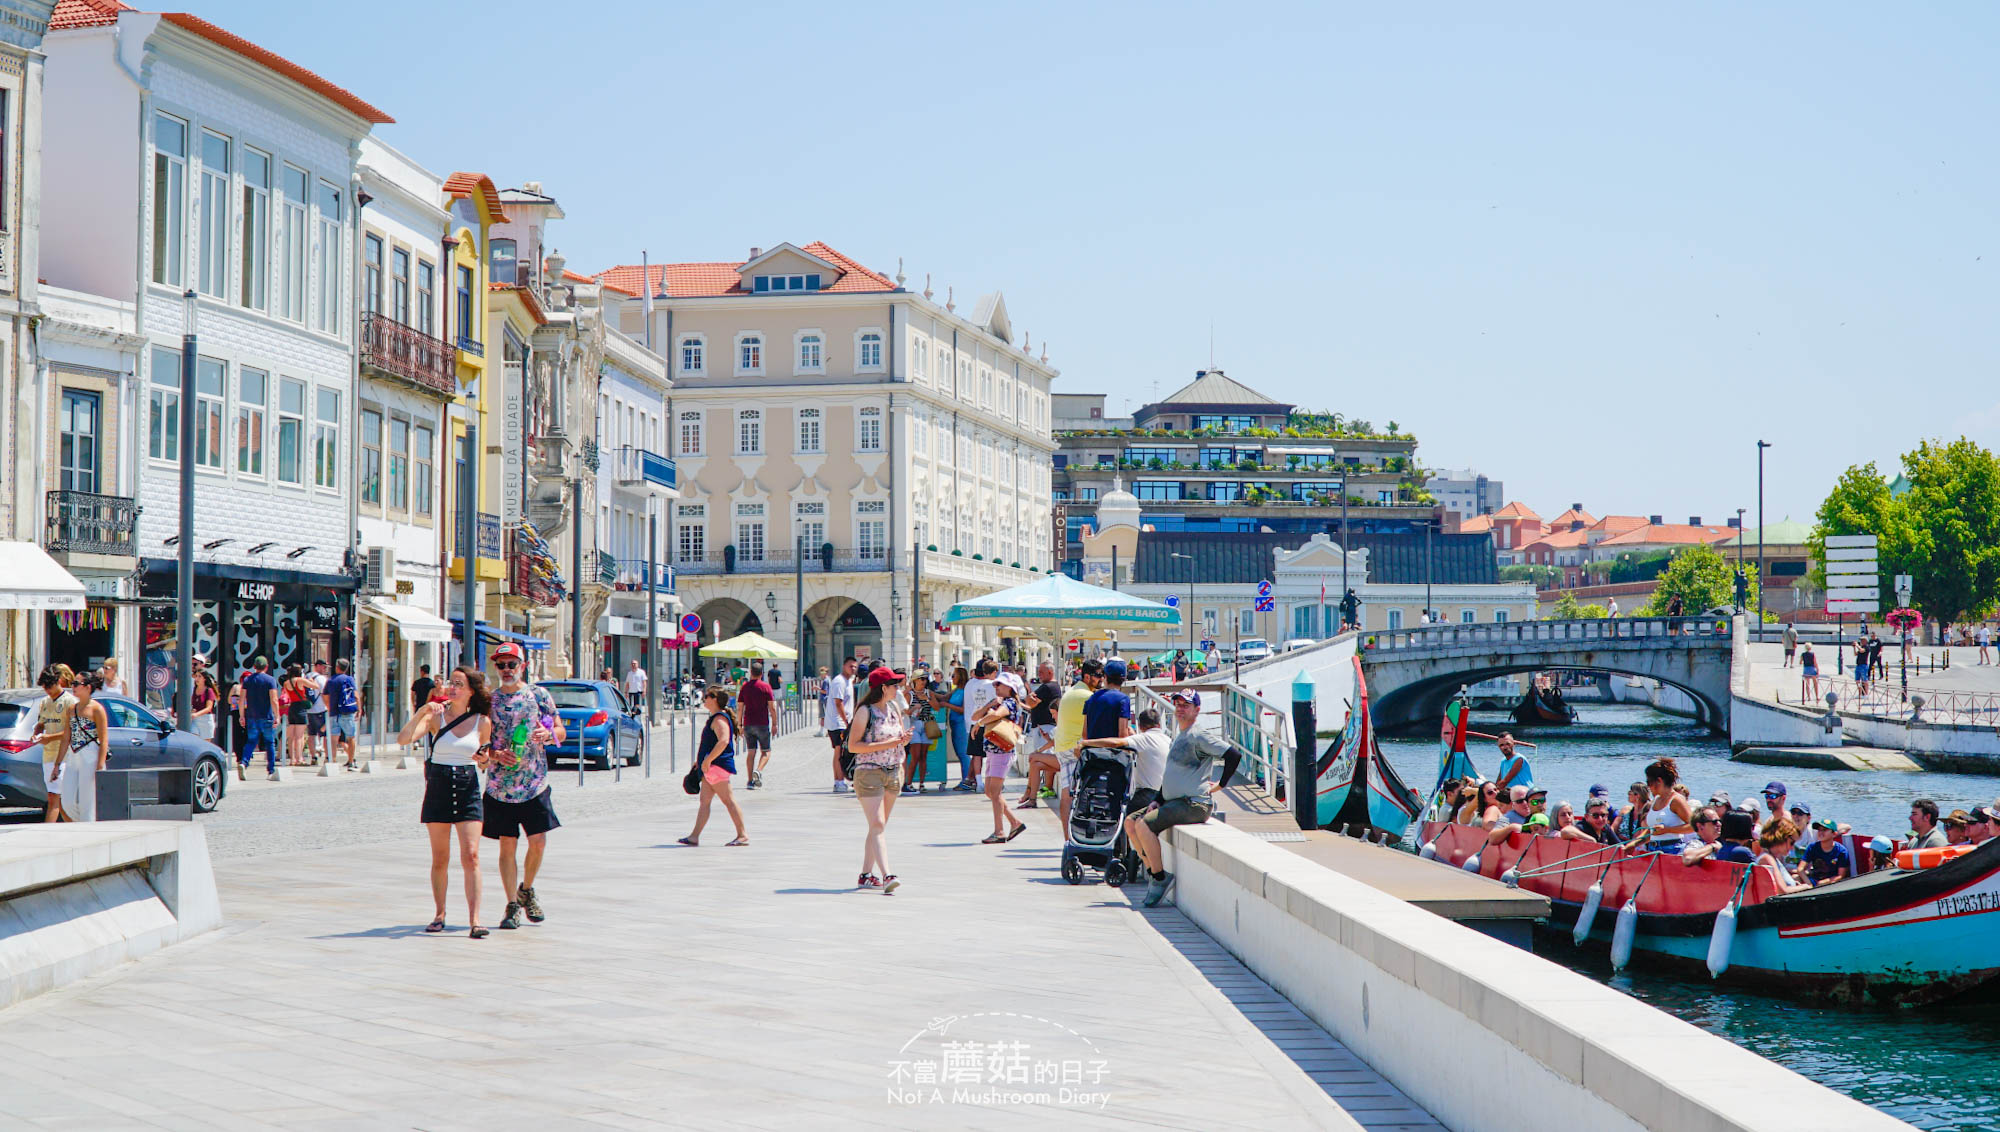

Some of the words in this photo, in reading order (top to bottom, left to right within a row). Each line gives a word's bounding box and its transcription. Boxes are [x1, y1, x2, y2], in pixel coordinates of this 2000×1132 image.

[508, 395, 518, 441] CIDADE
[507, 449, 517, 465] DA
[507, 473, 517, 517] MUSEU
[1056, 506, 1066, 560] HOTEL
[238, 581, 276, 600] ALE-HOP
[1120, 609, 1133, 617] DE
[1135, 609, 1169, 618] BARCO
